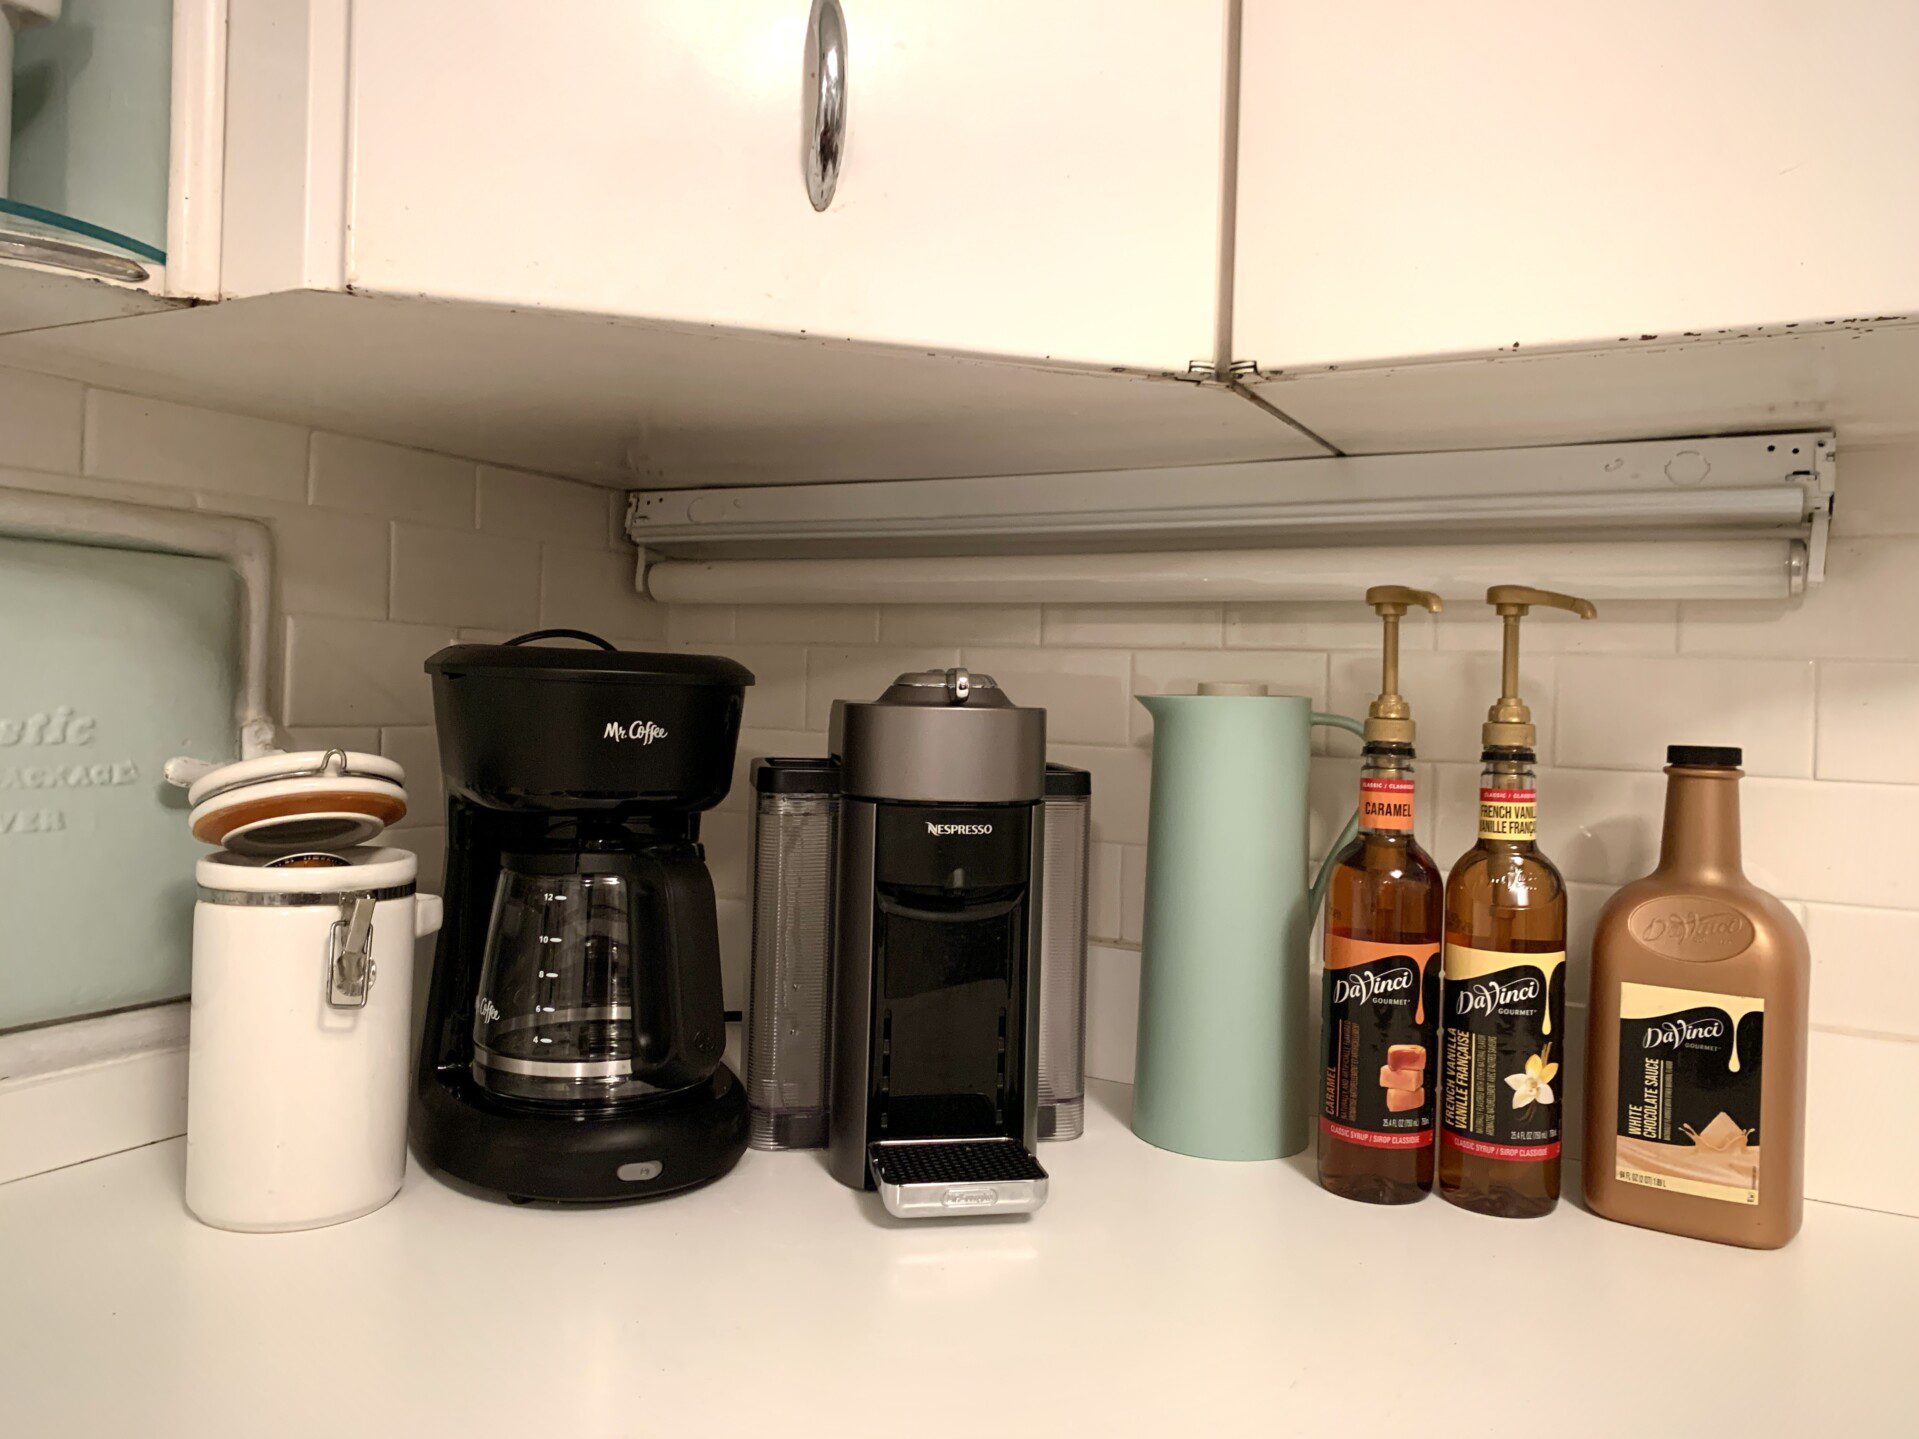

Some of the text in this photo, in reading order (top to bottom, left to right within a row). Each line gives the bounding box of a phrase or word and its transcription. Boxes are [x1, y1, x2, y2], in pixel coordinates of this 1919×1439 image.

[604, 720, 668, 745] Mr. Coffee
[1365, 801, 1411, 817] CARAMEL
[925, 821, 993, 836] NESPRESSO
[543, 893, 553, 901] 12
[539, 935, 549, 943] 10
[1333, 967, 1413, 1006] DaVinci
[1456, 977, 1539, 1017] DaVinci
[480, 997, 501, 1025] Coffee
[535, 1005, 541, 1013] 6
[1372, 997, 1408, 1006] GOURMET
[1498, 1008, 1534, 1016] GOURMET
[533, 1036, 539, 1044] 4
[1642, 1018, 1724, 1050] DaVinci
[1684, 1042, 1718, 1052] GOURMET
[1445, 1027, 1457, 1126] FRENCH VANILLA
[1455, 1029, 1472, 1129] VANILLE FRANÇAISE
[1325, 1066, 1336, 1115] CARAMEL
[1643, 1057, 1660, 1139] CHOCOLATE SAUCE
[1628, 1104, 1643, 1135] WHITE
[1330, 1124, 1350, 1138] CLASSIC
[1350, 1130, 1369, 1141] SYRUP
